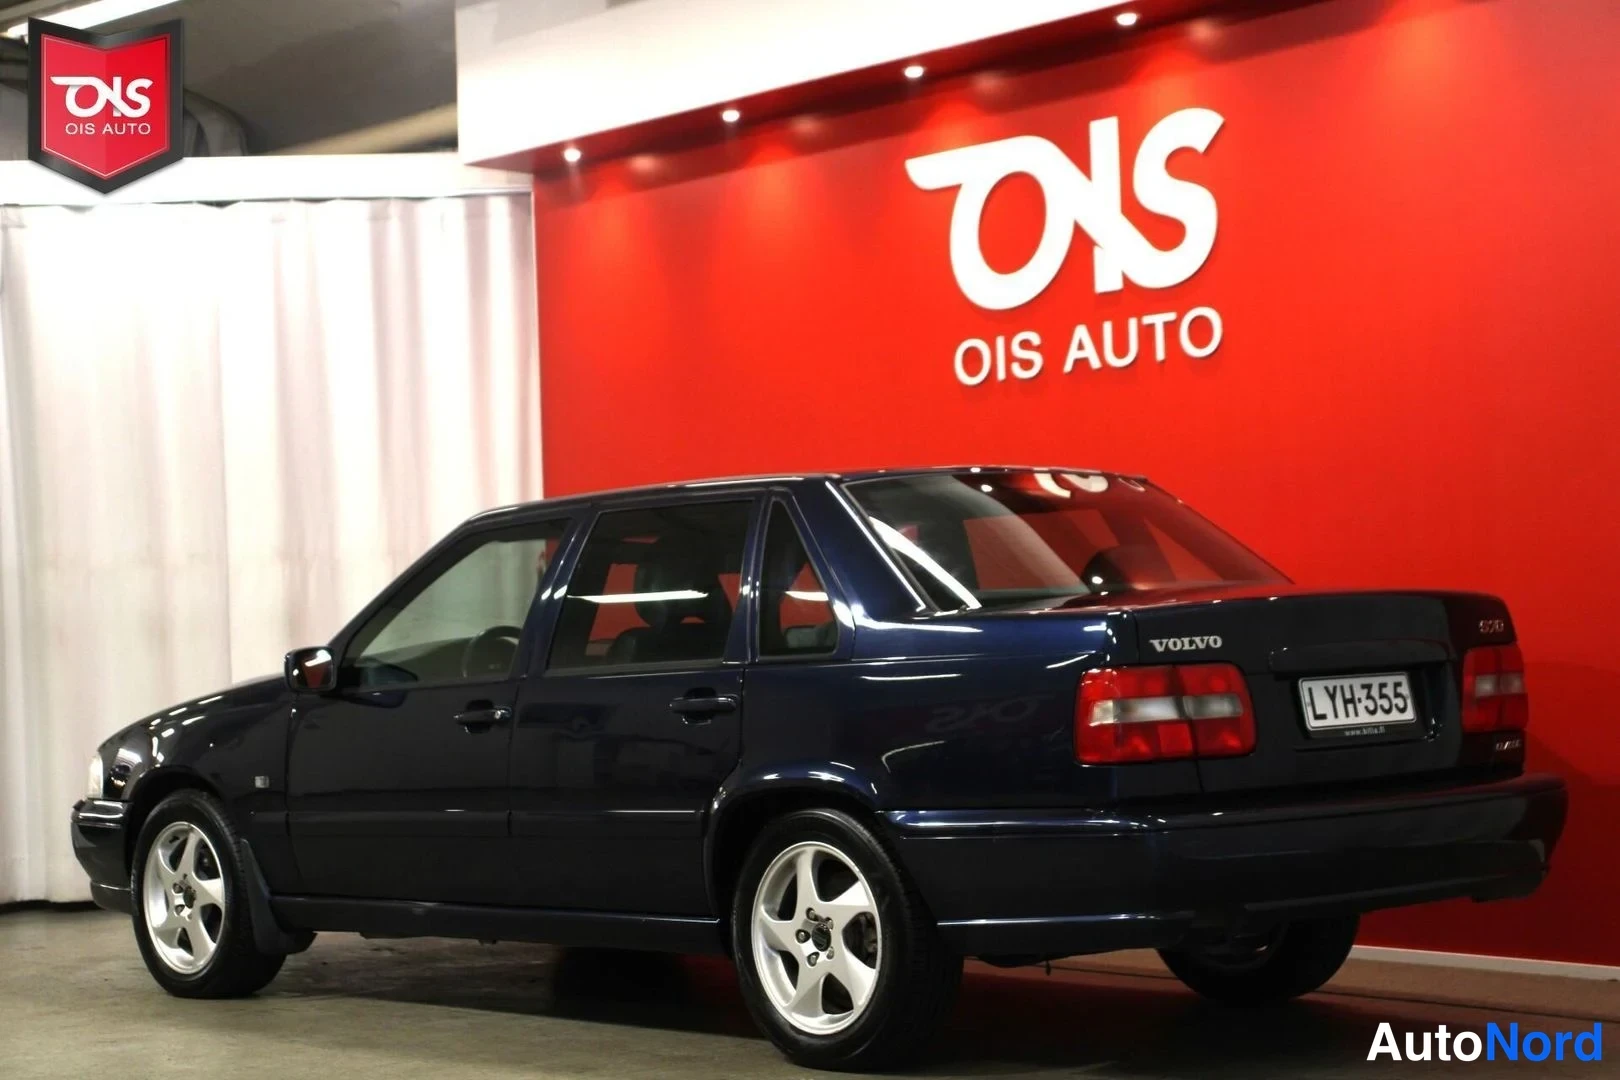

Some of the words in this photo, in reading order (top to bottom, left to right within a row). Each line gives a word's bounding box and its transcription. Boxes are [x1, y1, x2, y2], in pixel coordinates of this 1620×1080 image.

[905, 107, 1225, 310] OIS
[954, 331, 1044, 386] OIS
[1063, 306, 1224, 374] AUTO
[1150, 635, 1223, 653] VOLVO
